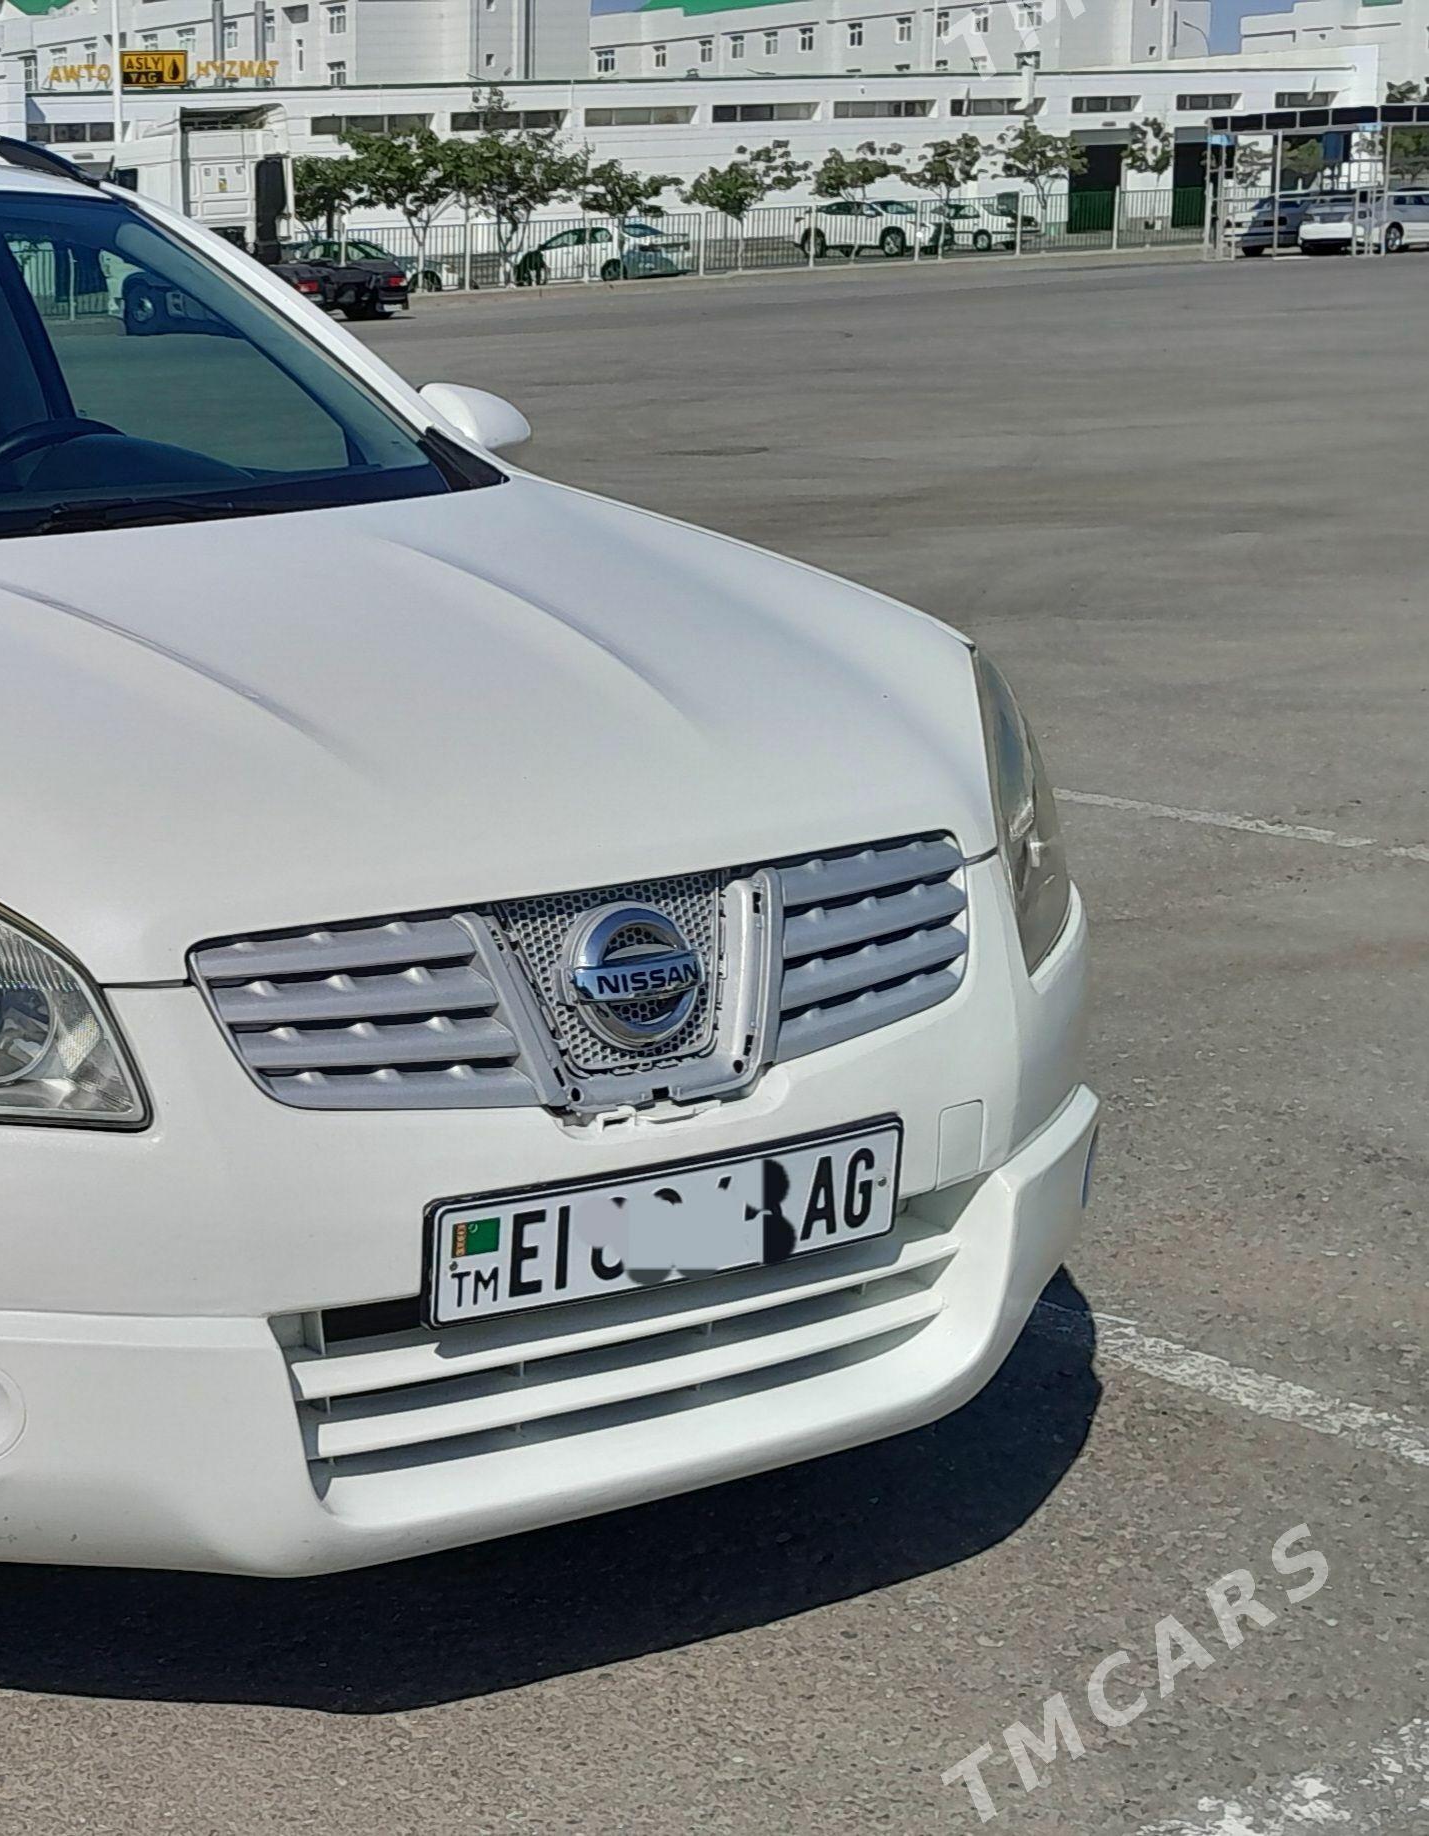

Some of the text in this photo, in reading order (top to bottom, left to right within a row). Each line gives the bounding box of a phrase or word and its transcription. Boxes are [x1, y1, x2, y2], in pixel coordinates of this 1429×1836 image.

[49, 60, 279, 83] AWTO HYZMAT
[125, 56, 161, 71] ASLY
[597, 961, 699, 994] NISSAN
[451, 1267, 499, 1307] TM
